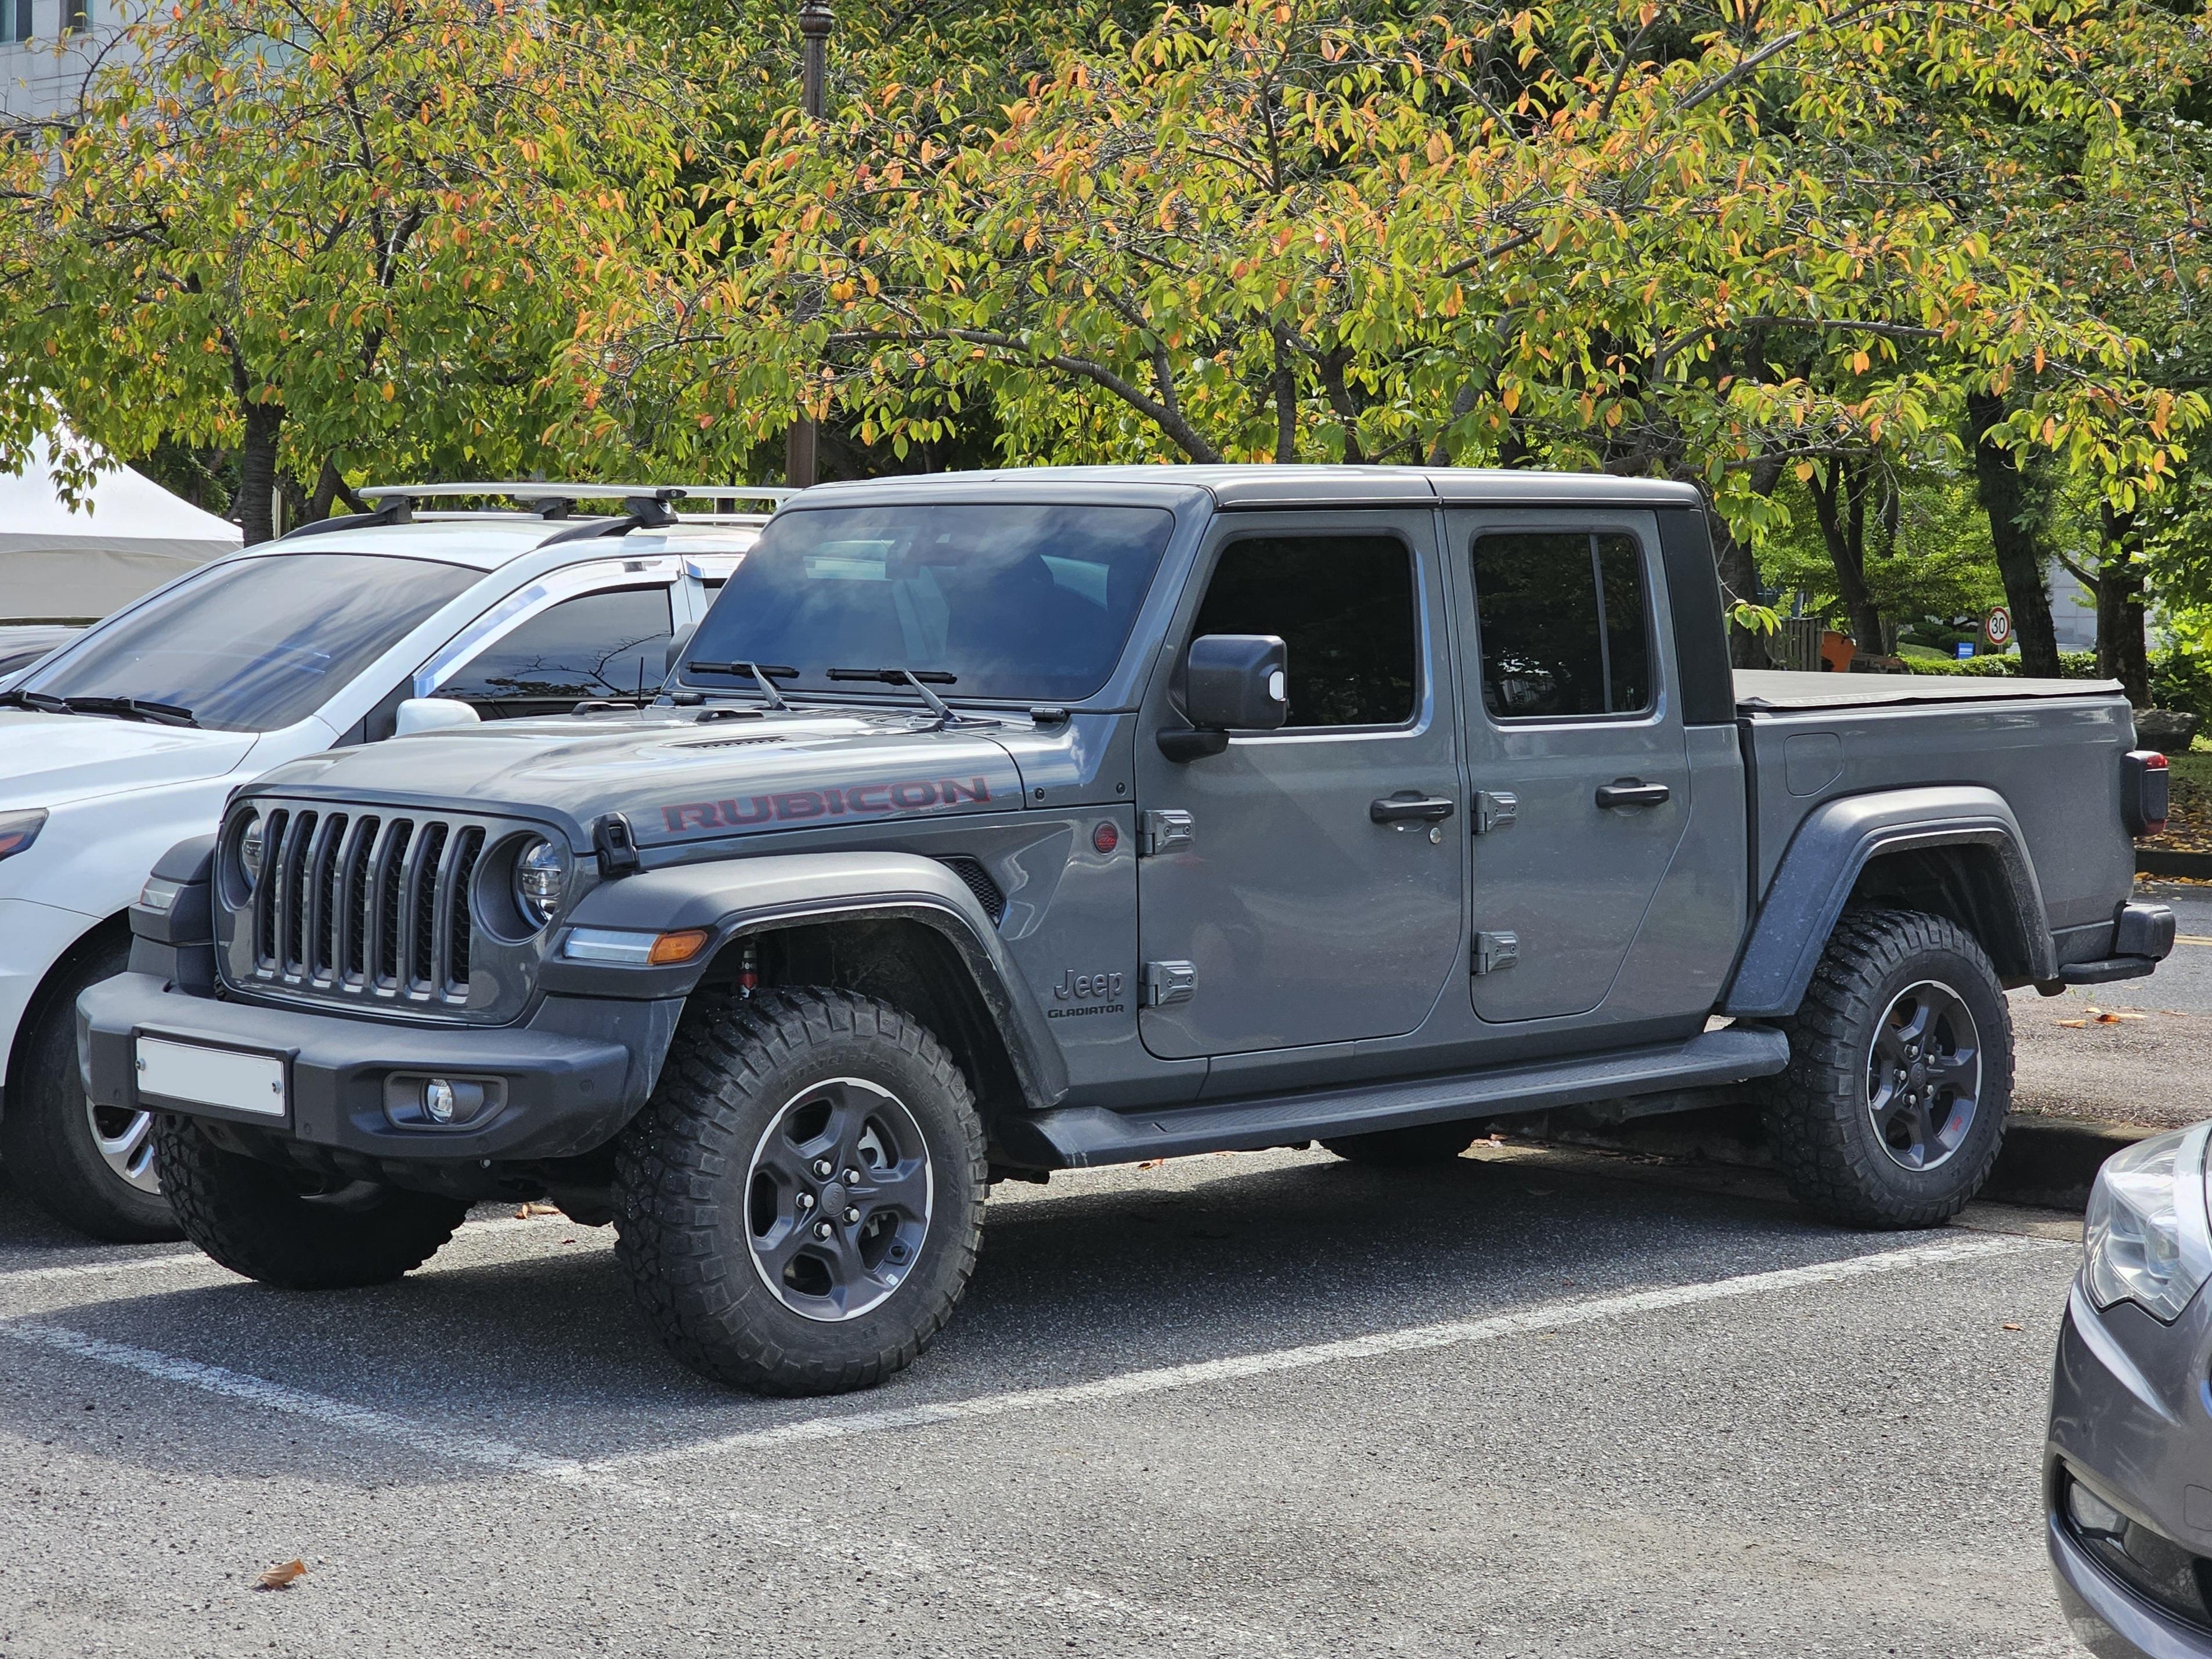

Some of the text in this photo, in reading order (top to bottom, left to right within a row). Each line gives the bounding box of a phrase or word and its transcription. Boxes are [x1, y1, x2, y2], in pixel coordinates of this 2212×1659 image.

[1992, 617, 2005, 634] 30
[661, 777, 990, 832] RUBICON
[1055, 969, 1124, 1002] Jeep
[1048, 1004, 1124, 1018] GLADIATOR
